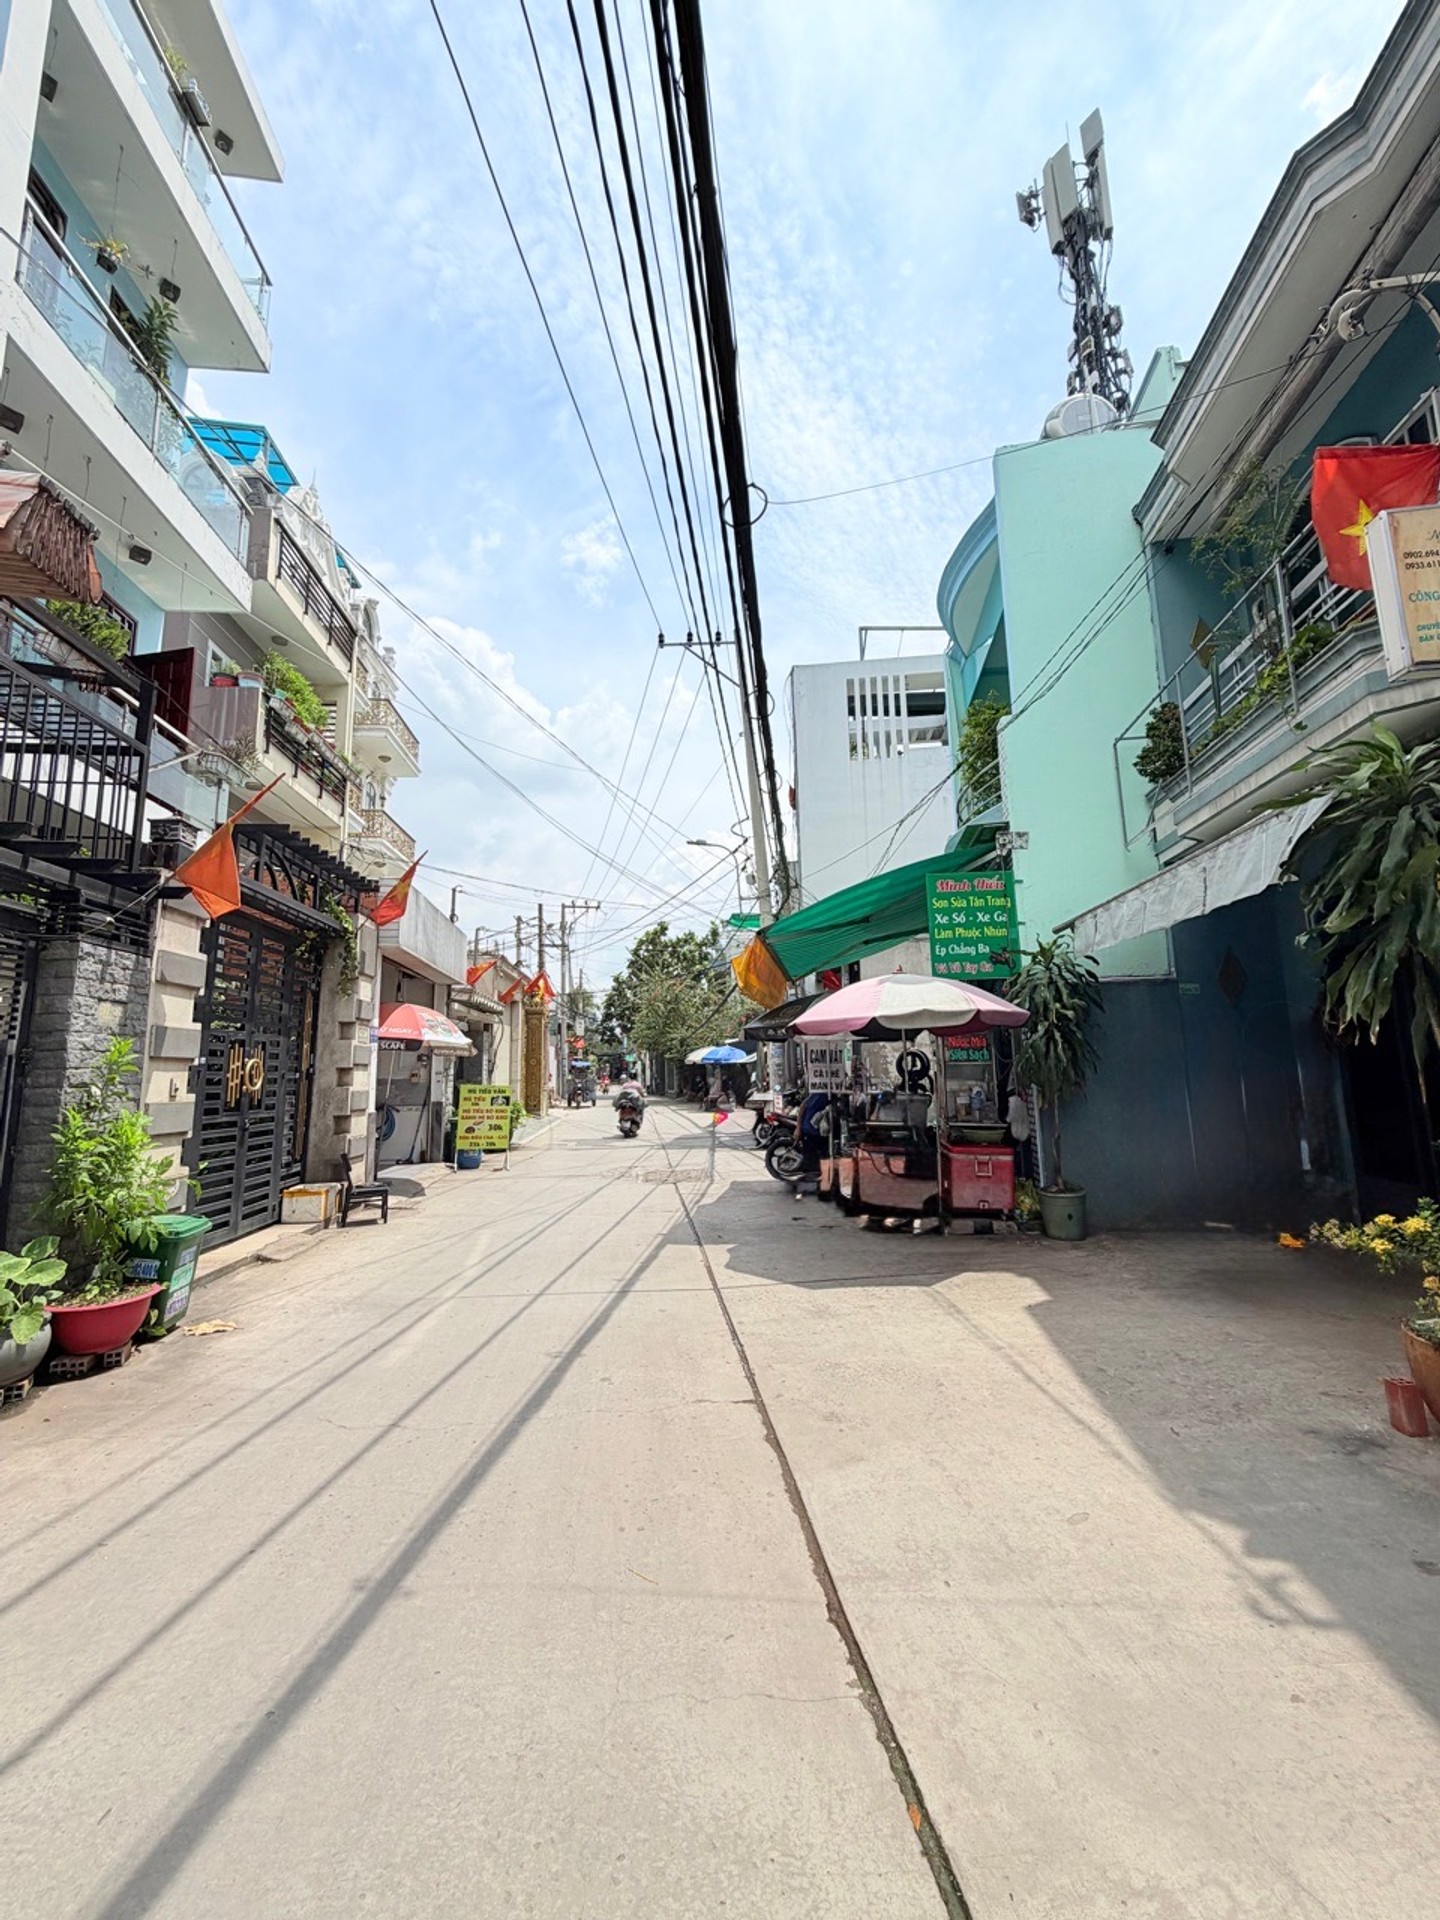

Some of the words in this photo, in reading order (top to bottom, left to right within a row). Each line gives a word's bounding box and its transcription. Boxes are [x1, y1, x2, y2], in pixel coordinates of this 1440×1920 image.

[986, 895, 1011, 908] Trang
[935, 913, 949, 923] Xe
[976, 912, 990, 923] Xe
[994, 911, 1007, 922] Ga
[934, 928, 953, 938] Làm
[978, 943, 989, 953] Ba
[810, 1049, 827, 1064] CAM
